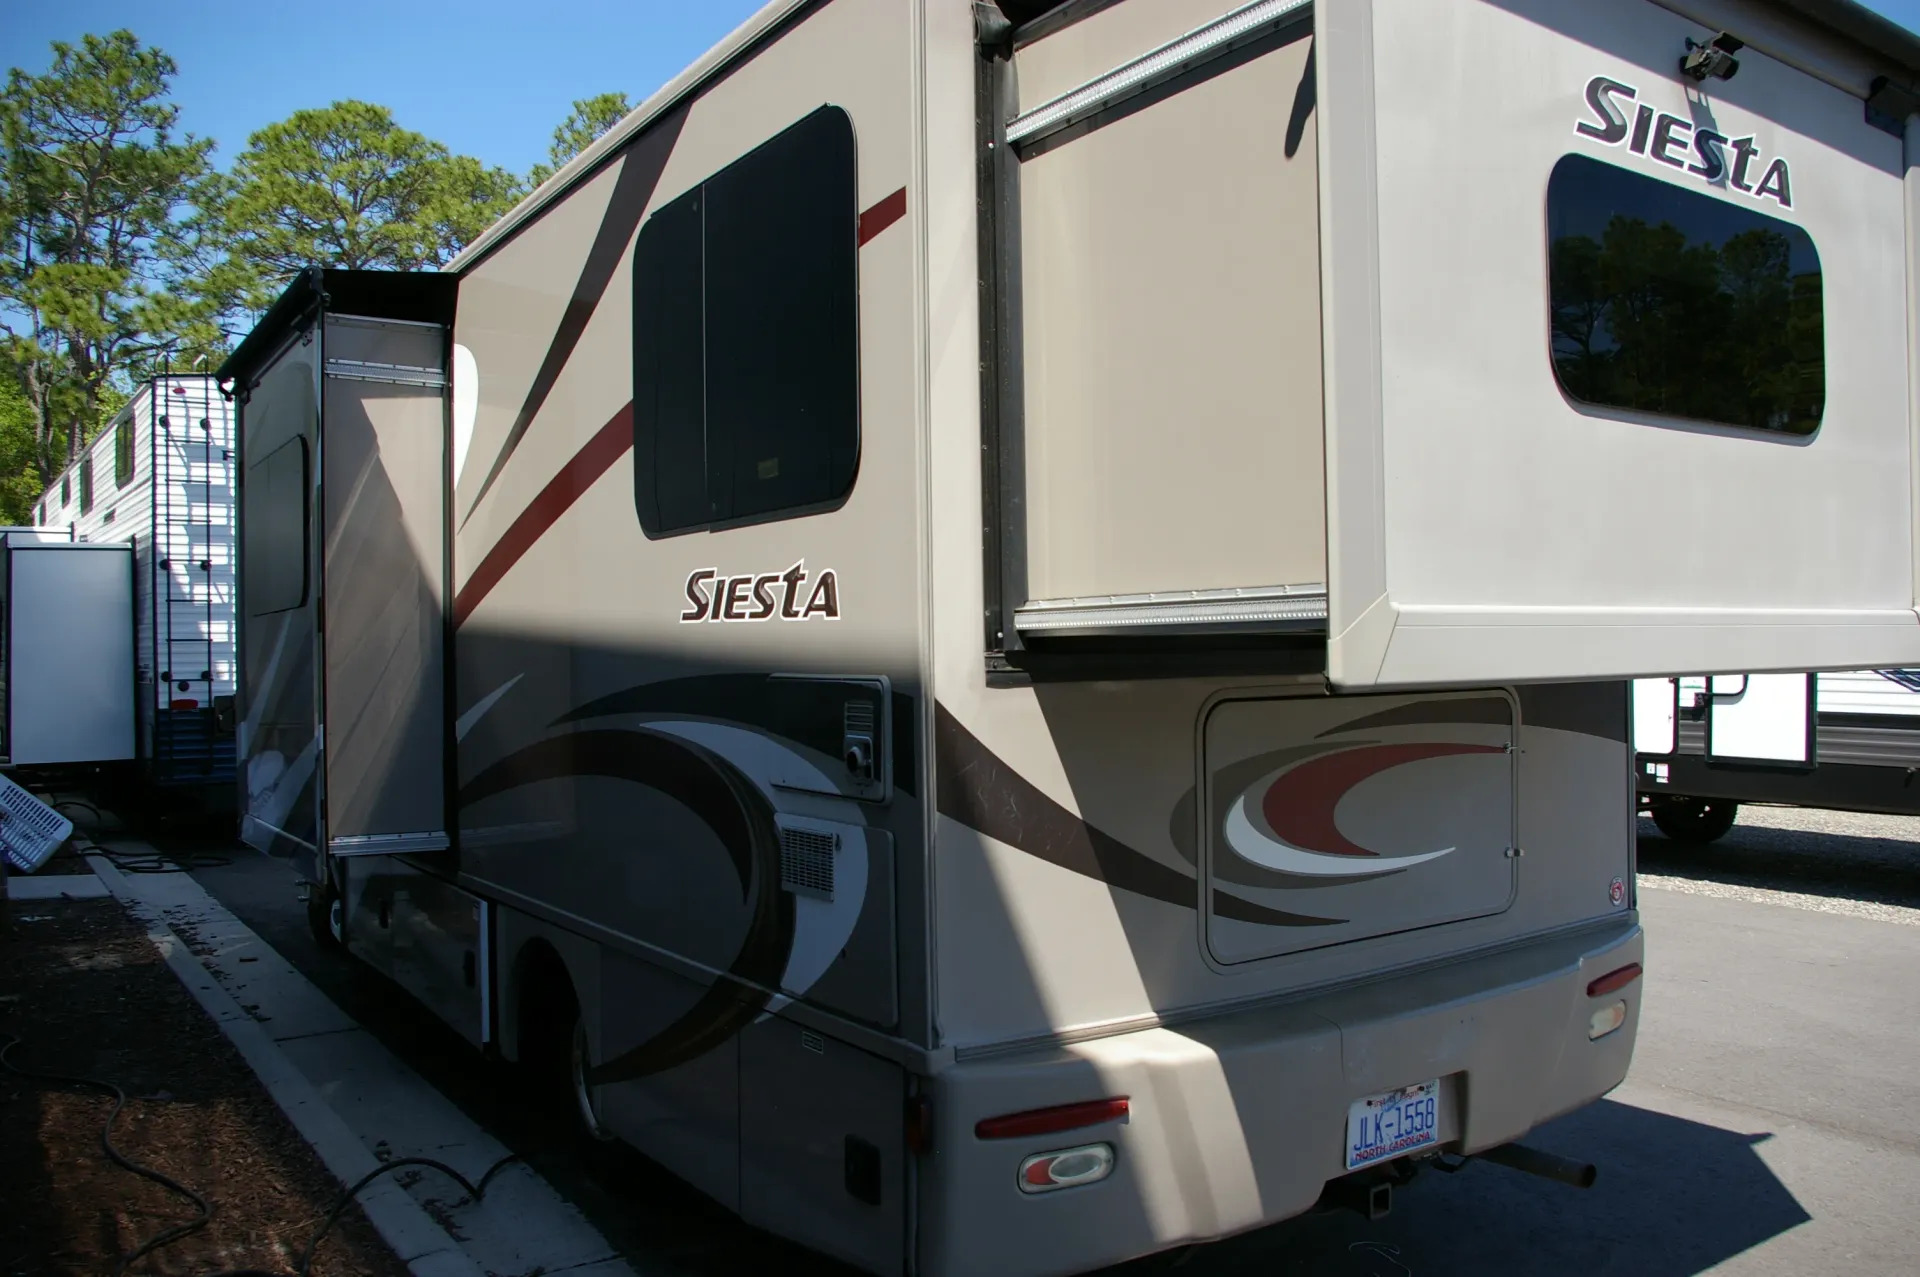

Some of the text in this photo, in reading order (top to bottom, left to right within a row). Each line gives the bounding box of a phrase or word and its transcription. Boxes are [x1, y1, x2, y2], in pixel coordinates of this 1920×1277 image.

[1354, 1097, 1434, 1150] JLK-1558
[1355, 1131, 1430, 1160] NORTH CAROLINA
